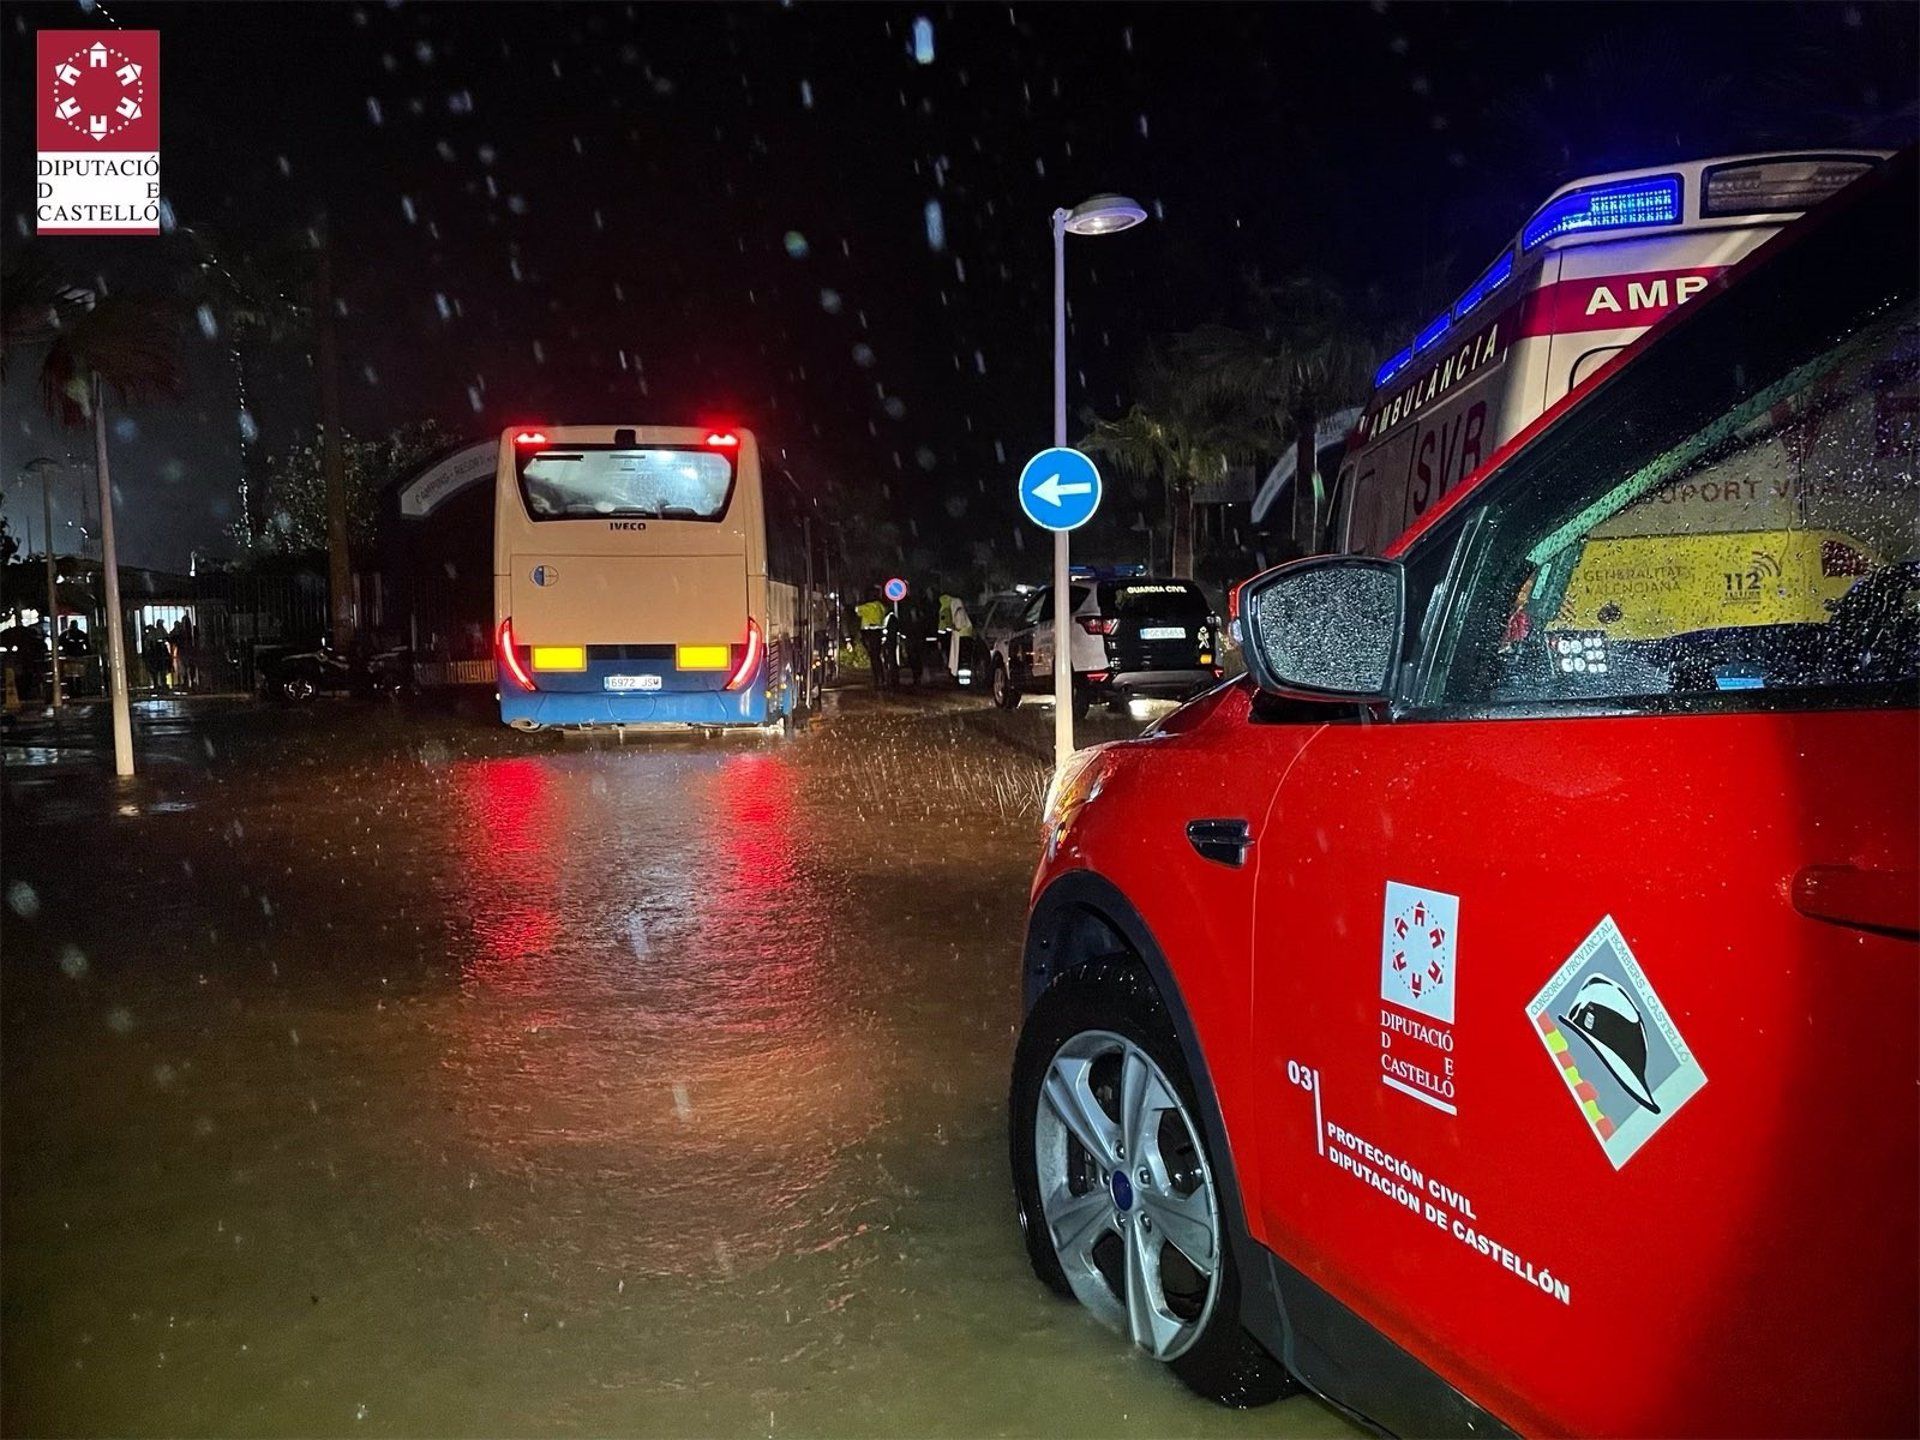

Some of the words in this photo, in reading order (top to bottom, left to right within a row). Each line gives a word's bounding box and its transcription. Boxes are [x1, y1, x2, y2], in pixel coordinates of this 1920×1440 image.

[610, 522, 647, 531] IVECO
[1127, 585, 1165, 594] GUARDIA
[1165, 584, 1188, 593] CIVIL
[1583, 564, 1685, 582] GENERALITAT
[1586, 580, 1682, 595] VALENCIANA
[1723, 572, 1761, 590] 112
[611, 678, 636, 687] 6972
[1530, 971, 1568, 1016] CONSORCI
[1565, 922, 1613, 976] PROVINCIAL
[1611, 932, 1646, 989] BOMBERS
[1380, 1009, 1454, 1052] DIPUTACIÓ
[1381, 1031, 1391, 1048] D
[1444, 1057, 1454, 1076] E
[1287, 1060, 1313, 1091] 03
[1381, 1053, 1455, 1098] CASTELLÓ
[1327, 1121, 1424, 1190] PROTECCIÓN
[1429, 1179, 1477, 1220] CIVIL
[1329, 1146, 1421, 1214] DIPUTACIÓN
[1425, 1202, 1448, 1231] DE
[1452, 1220, 1570, 1305] CASTELLÓN
